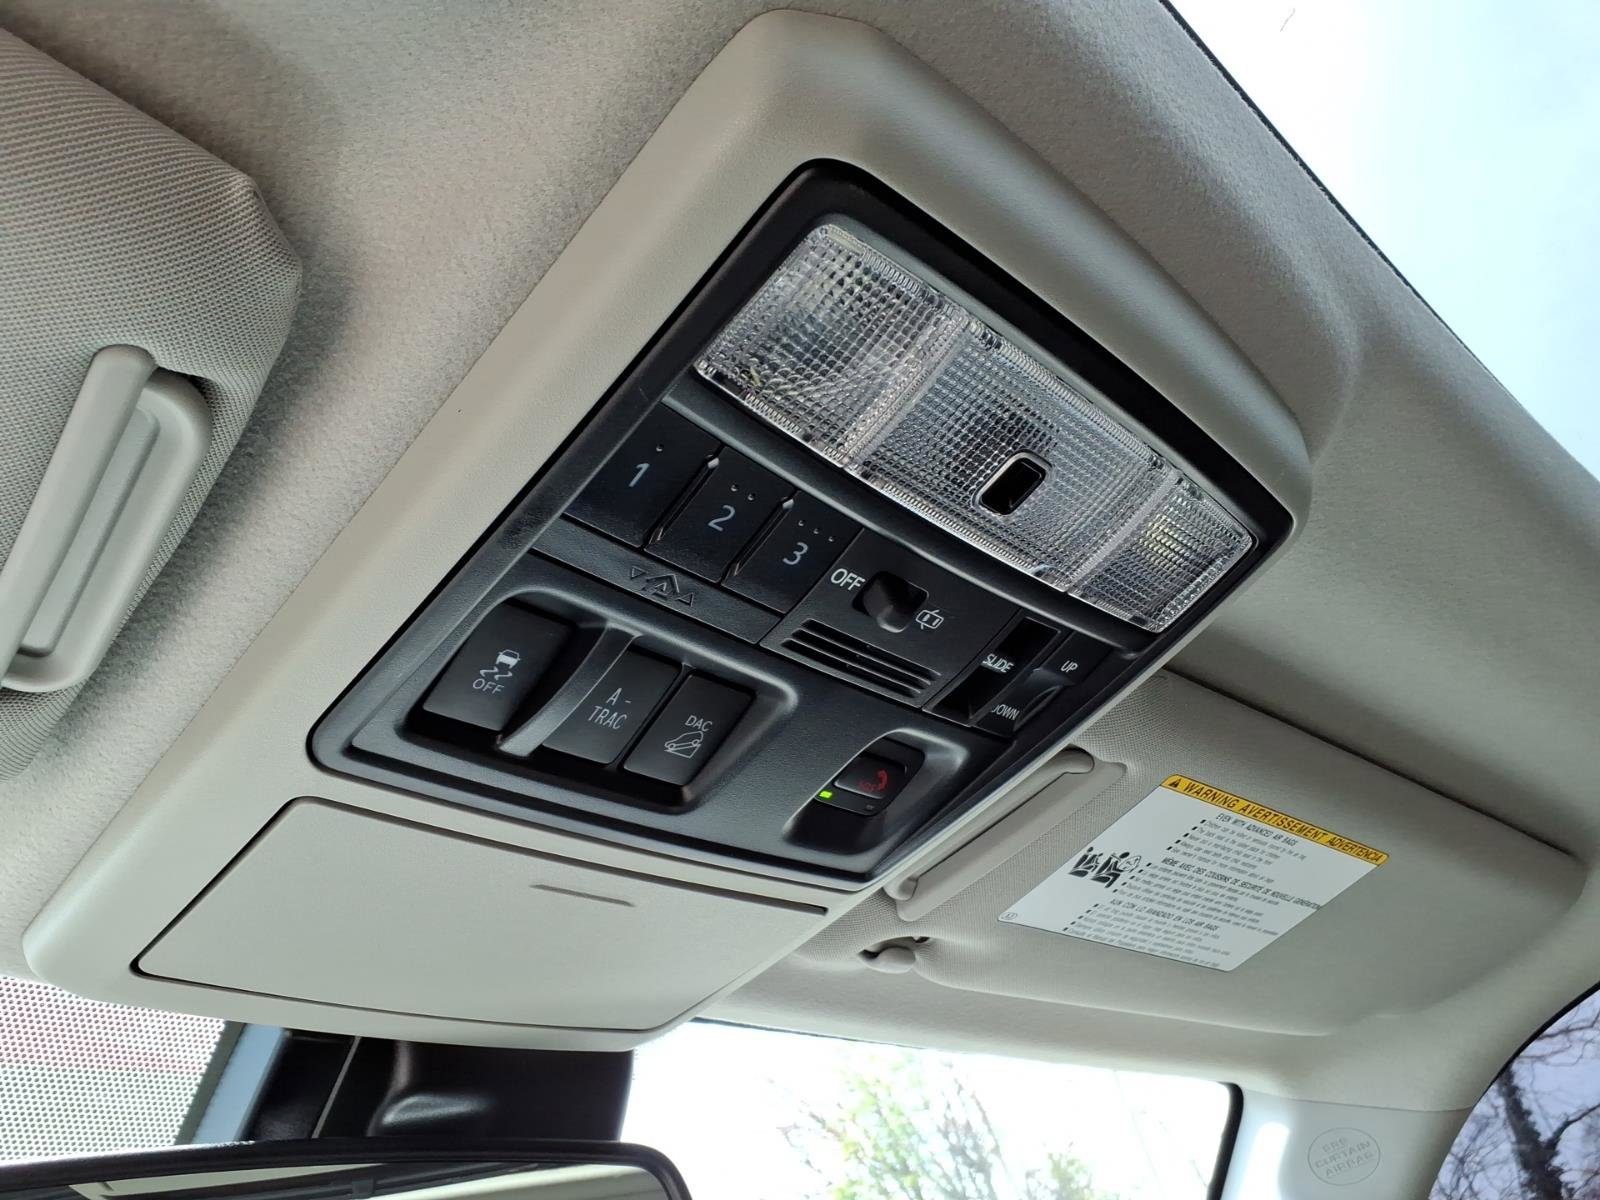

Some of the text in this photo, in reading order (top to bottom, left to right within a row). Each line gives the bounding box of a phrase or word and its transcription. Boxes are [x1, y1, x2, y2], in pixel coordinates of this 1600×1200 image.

[628, 462, 650, 487] 1
[708, 504, 736, 532] 2
[782, 542, 809, 566] 3
[829, 568, 866, 592] OFF
[982, 653, 1015, 673] SLIDE
[1060, 660, 1079, 673] UP
[472, 678, 505, 695] OFF
[587, 705, 628, 730] TRAC
[684, 715, 713, 732] DAC
[1184, 781, 1240, 809] WARNING
[1240, 803, 1327, 840] AVERTISSEMENT
[1327, 834, 1383, 863] ADVERTENCIA
